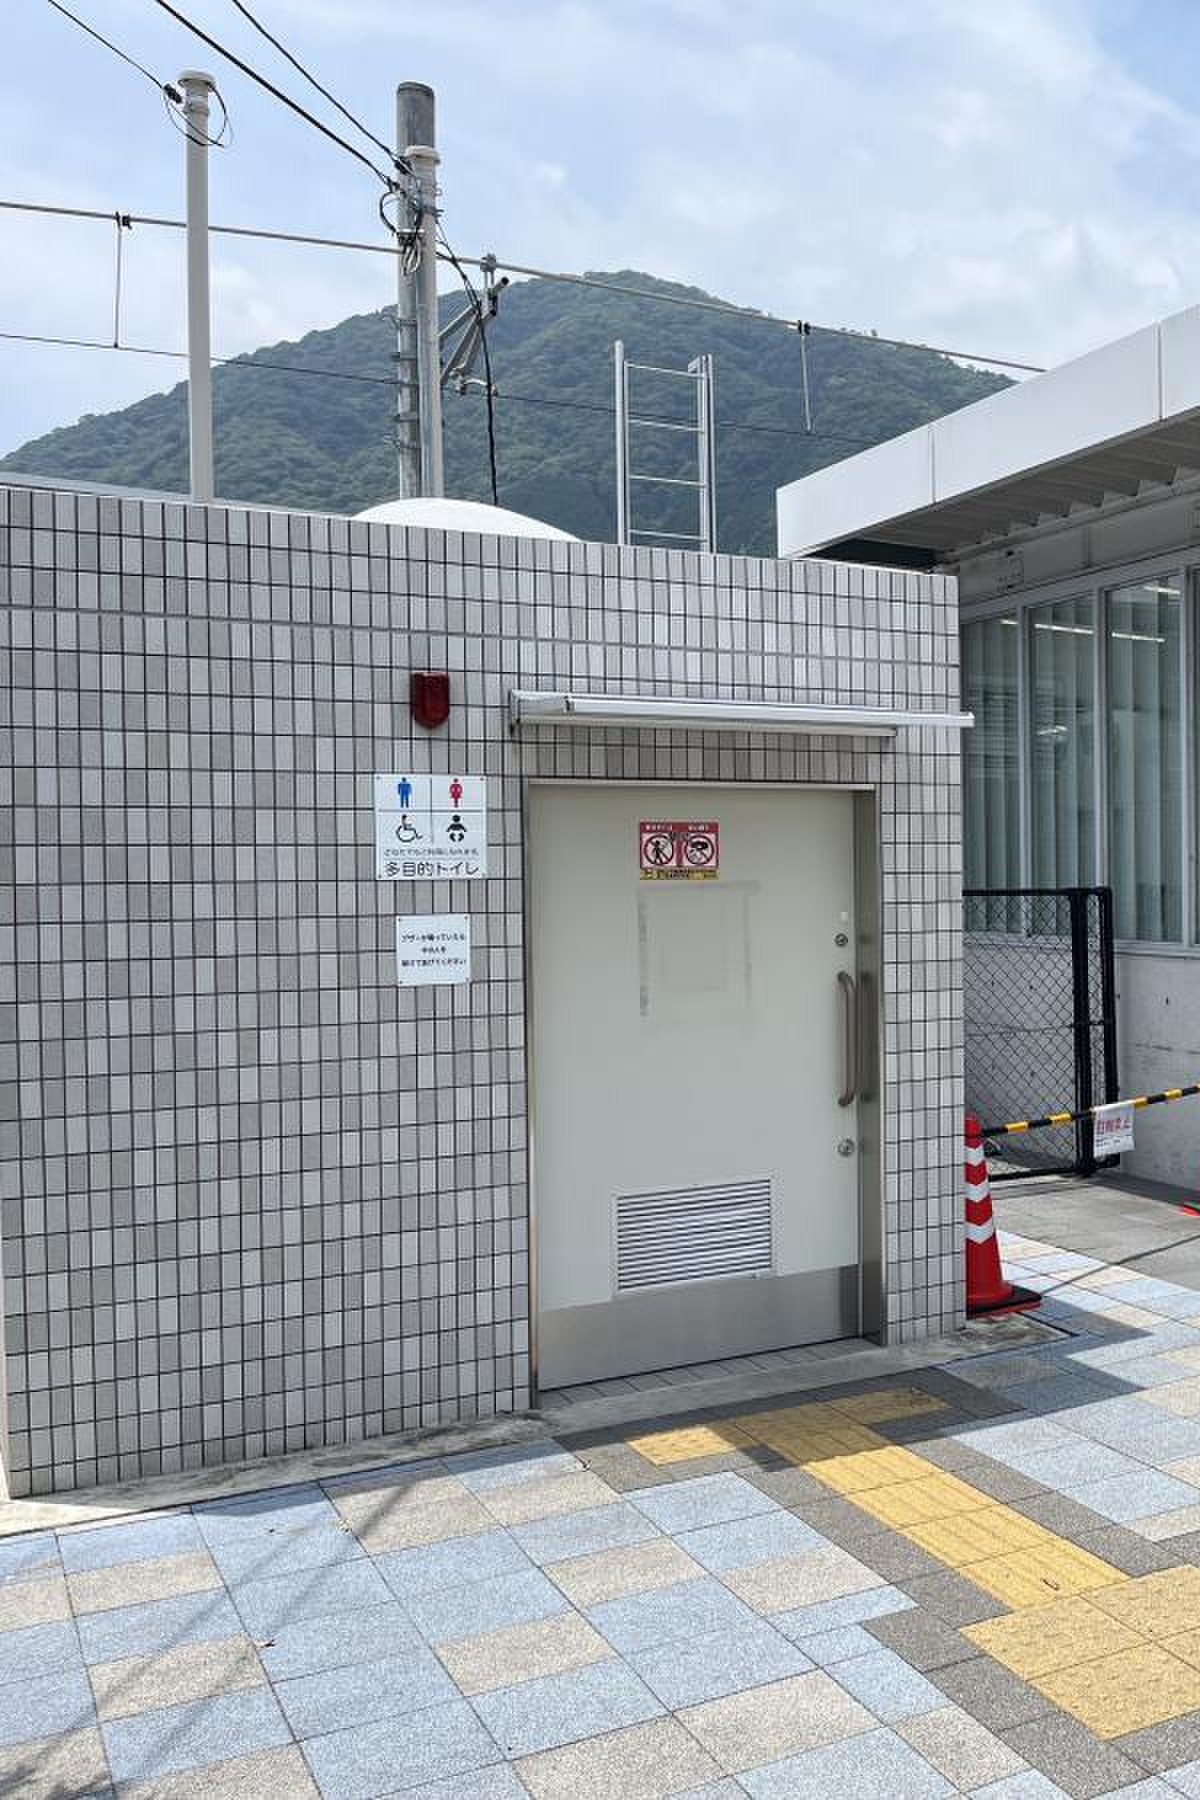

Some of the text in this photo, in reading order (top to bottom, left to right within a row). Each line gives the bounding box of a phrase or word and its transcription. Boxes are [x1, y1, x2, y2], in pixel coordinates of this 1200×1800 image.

[386, 862, 480, 877] 多目的トイレ
